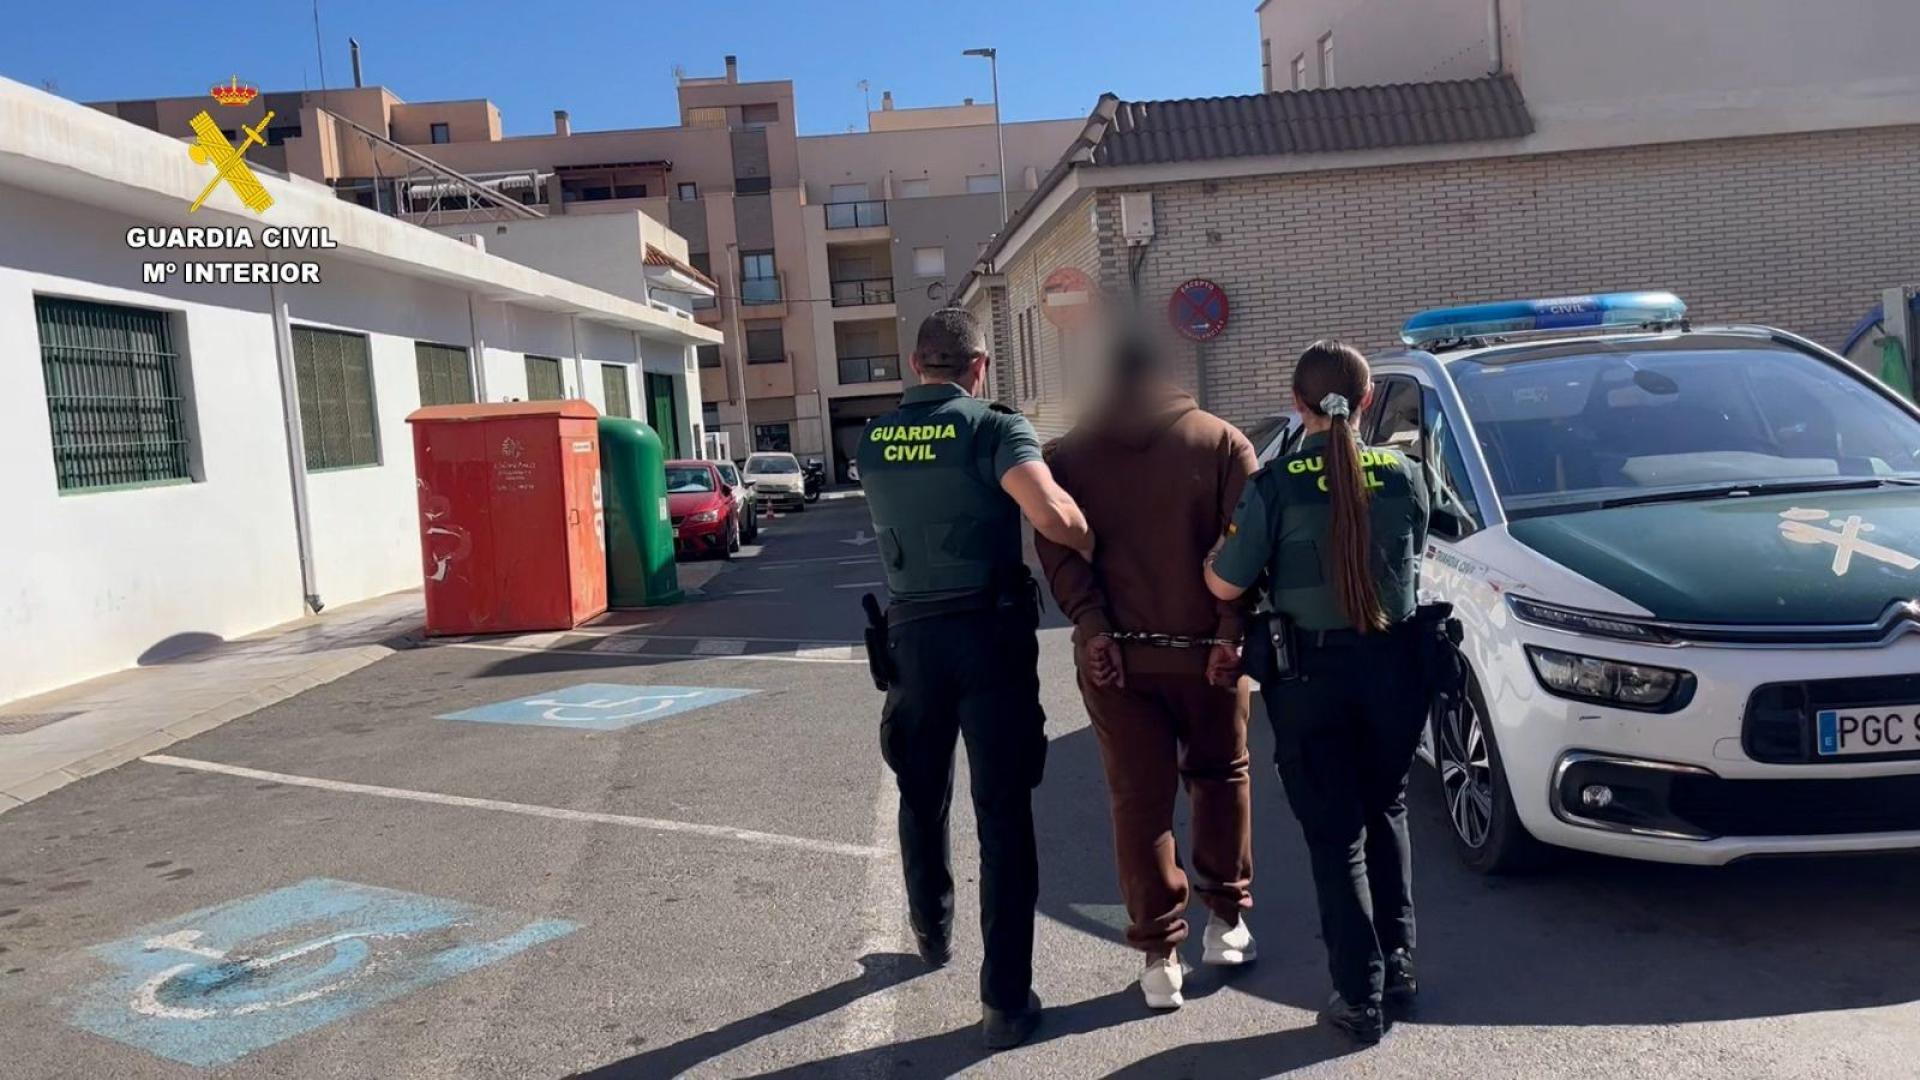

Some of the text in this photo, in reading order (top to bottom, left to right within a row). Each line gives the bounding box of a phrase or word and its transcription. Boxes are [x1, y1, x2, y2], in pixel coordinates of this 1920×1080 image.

[1551, 303, 1584, 314] CIVIL
[870, 424, 956, 442] GUARDIA
[884, 444, 937, 461] CIVIL
[1287, 451, 1399, 474] GUDIA
[1317, 471, 1384, 492] CIL
[1839, 713, 1903, 748] PGC
[1825, 736, 1832, 746] E
